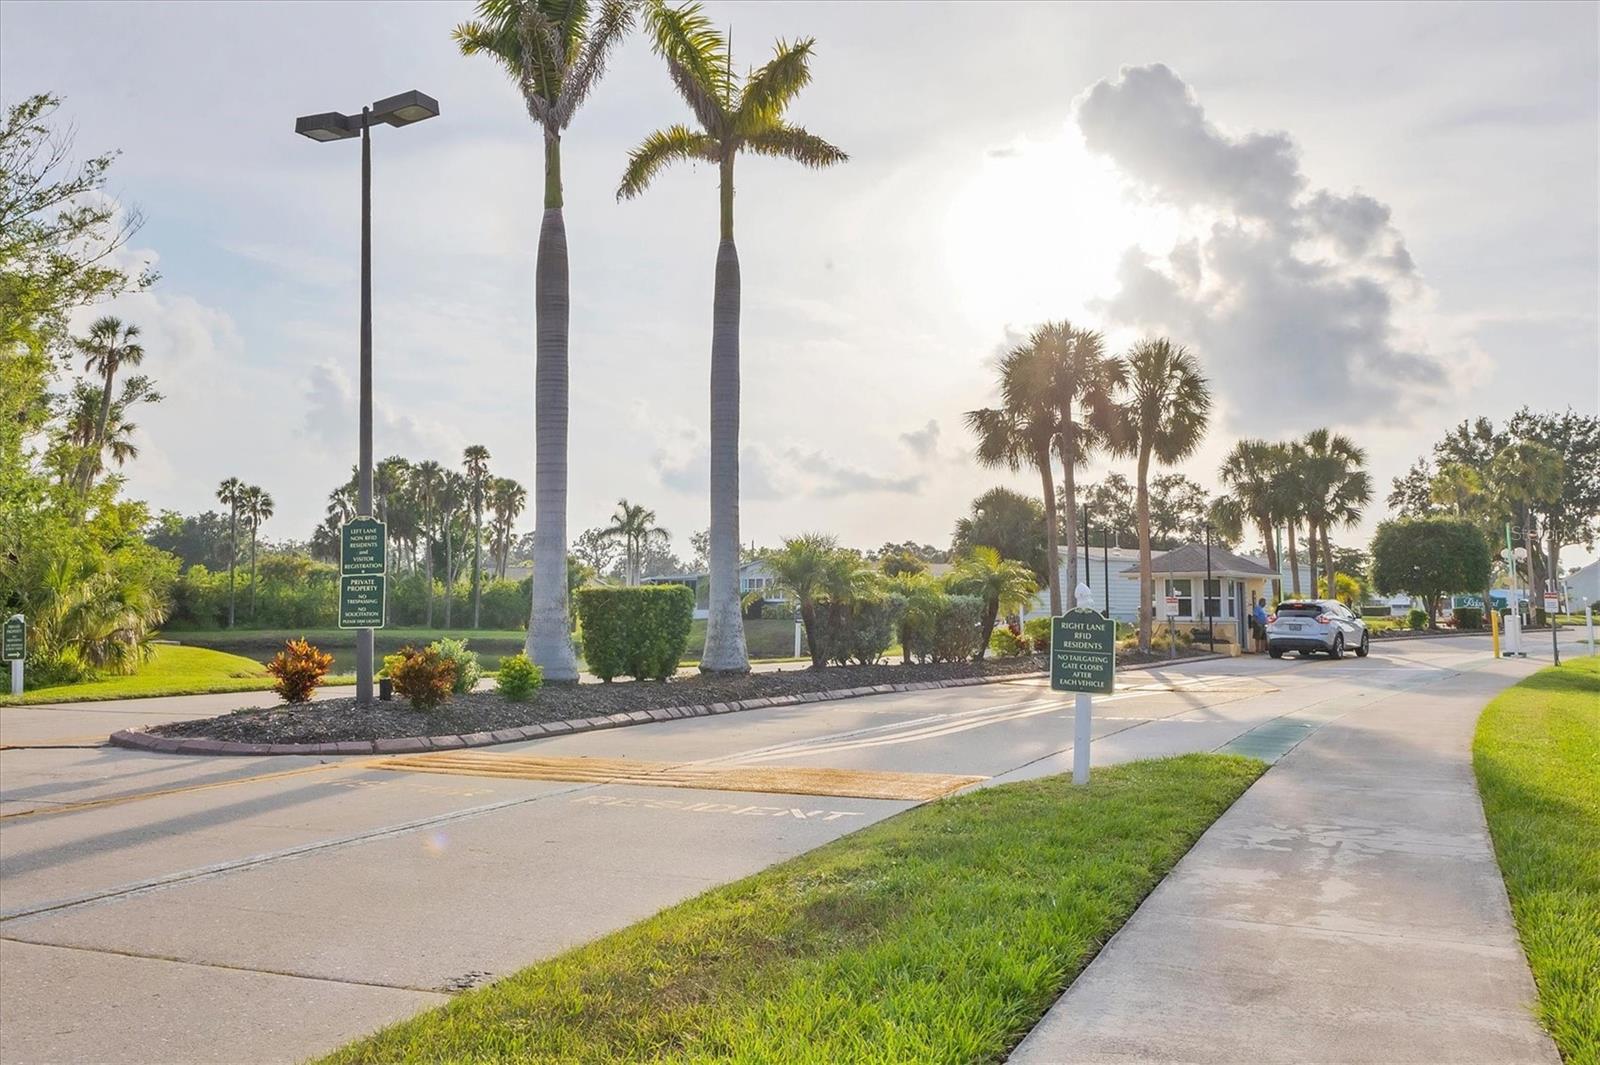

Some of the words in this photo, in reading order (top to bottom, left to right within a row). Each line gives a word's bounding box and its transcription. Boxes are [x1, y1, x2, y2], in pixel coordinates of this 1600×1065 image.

[1063, 641, 1103, 649] RESIDENTS
[1069, 655, 1108, 663] TAILGATING
[570, 795, 865, 822] RESIDENT
